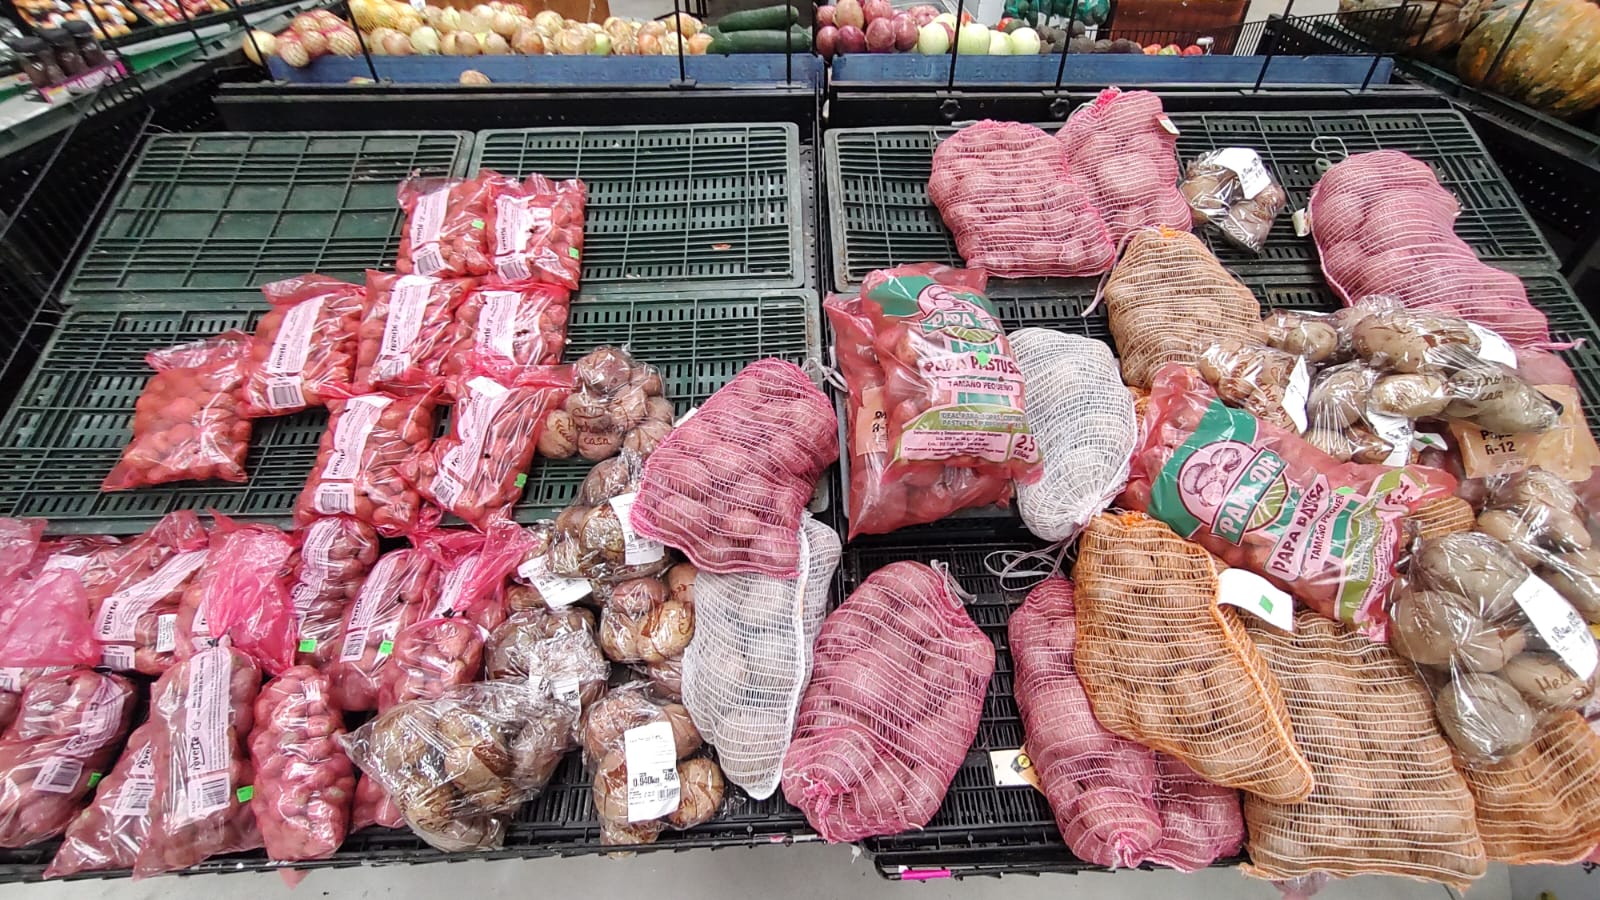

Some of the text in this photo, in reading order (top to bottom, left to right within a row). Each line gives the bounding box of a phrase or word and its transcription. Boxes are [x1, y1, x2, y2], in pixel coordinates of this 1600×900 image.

[1485, 441, 1515, 455] R-12
[1219, 485, 1261, 534] PAPA
[1311, 494, 1345, 560] TAMAÑO PEQUEÑ
[1271, 531, 1301, 573] PAPA
[102, 601, 119, 635] reverte
[138, 745, 151, 769] rever
[193, 736, 201, 770] reverte
